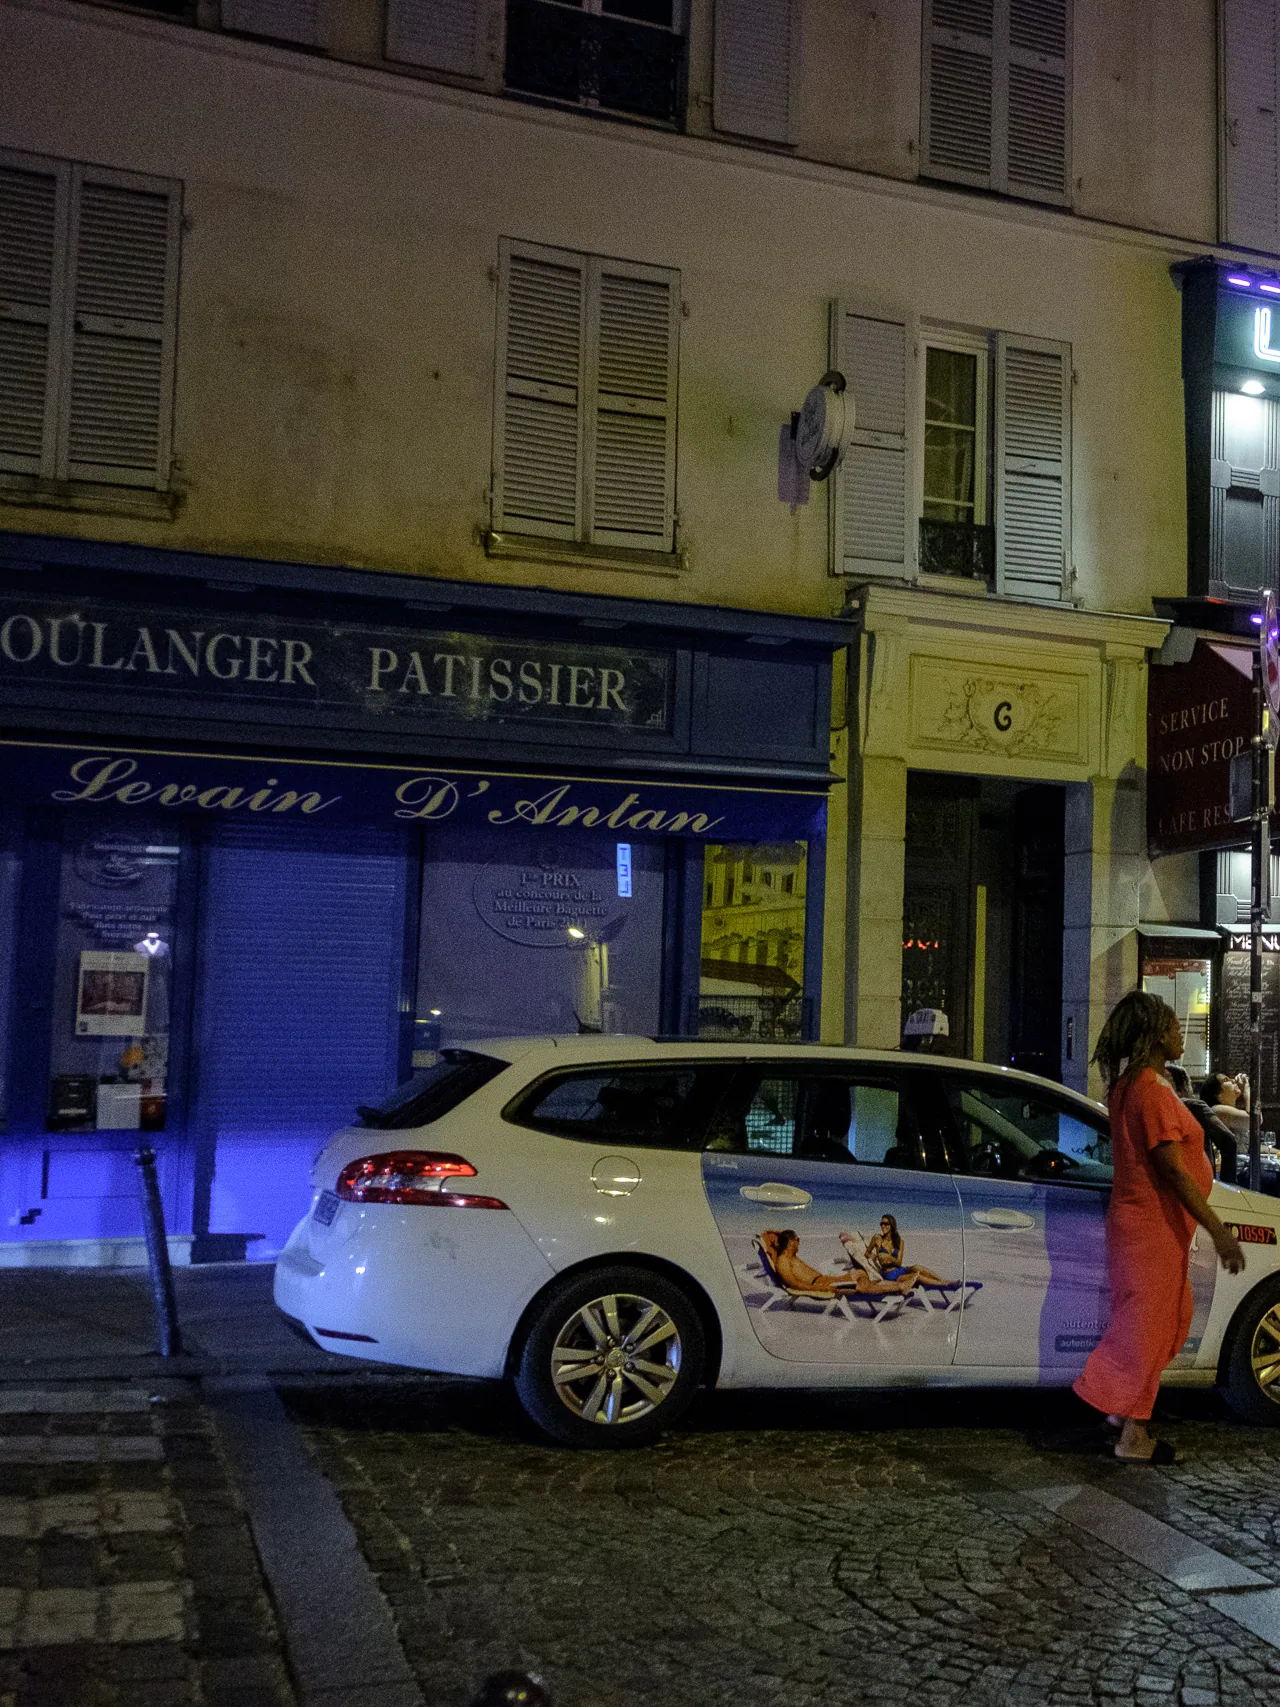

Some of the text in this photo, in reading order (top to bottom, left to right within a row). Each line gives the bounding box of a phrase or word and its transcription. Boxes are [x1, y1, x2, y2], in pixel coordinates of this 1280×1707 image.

[366, 646, 631, 711] PATISSIER
[994, 701, 1012, 732] G
[1159, 698, 1229, 735] SERVICE
[1160, 736, 1244, 773] NON STOP
[51, 756, 343, 814] Levain
[516, 890, 570, 900] concours
[543, 873, 580, 886] PRIX
[494, 901, 608, 917] Meilleure Baguette
[507, 916, 522, 927] de
[526, 916, 557, 928] Paris
